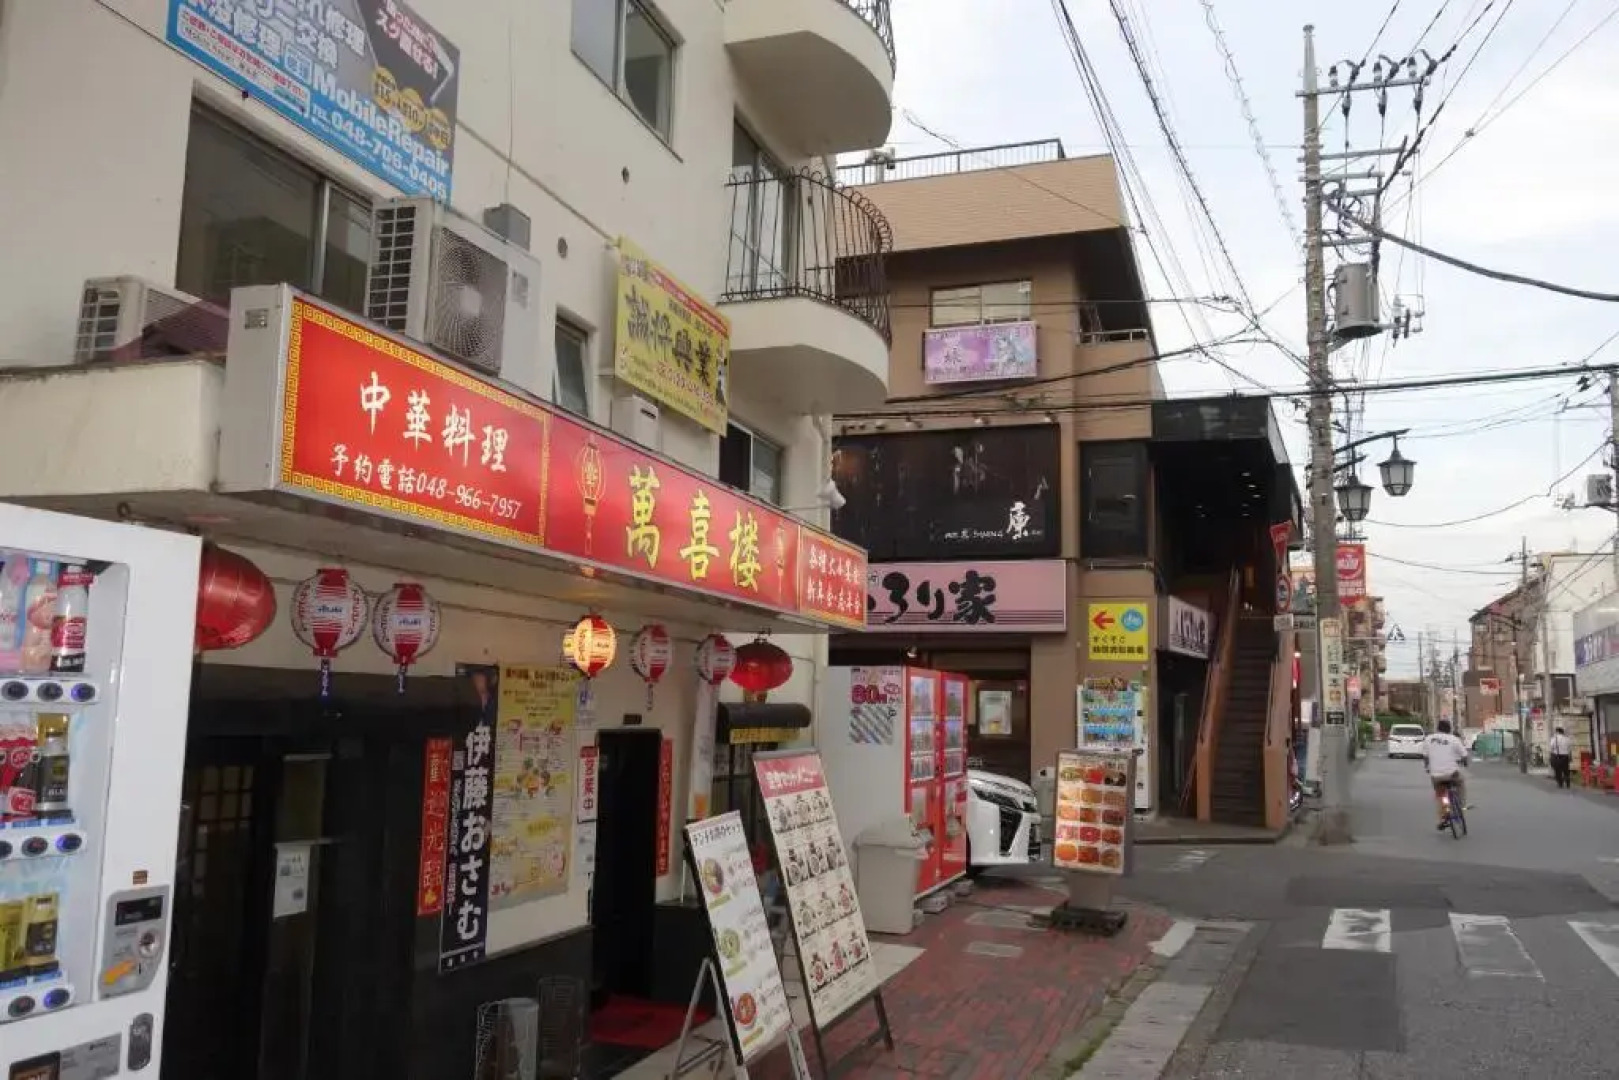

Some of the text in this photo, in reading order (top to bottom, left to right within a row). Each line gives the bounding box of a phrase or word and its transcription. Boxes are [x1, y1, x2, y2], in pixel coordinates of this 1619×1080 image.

[313, 64, 451, 177] MobileRepair
[359, 371, 509, 472] 中華料理
[867, 570, 997, 625] ろり家
[456, 721, 492, 941] 伊藤おさむ
